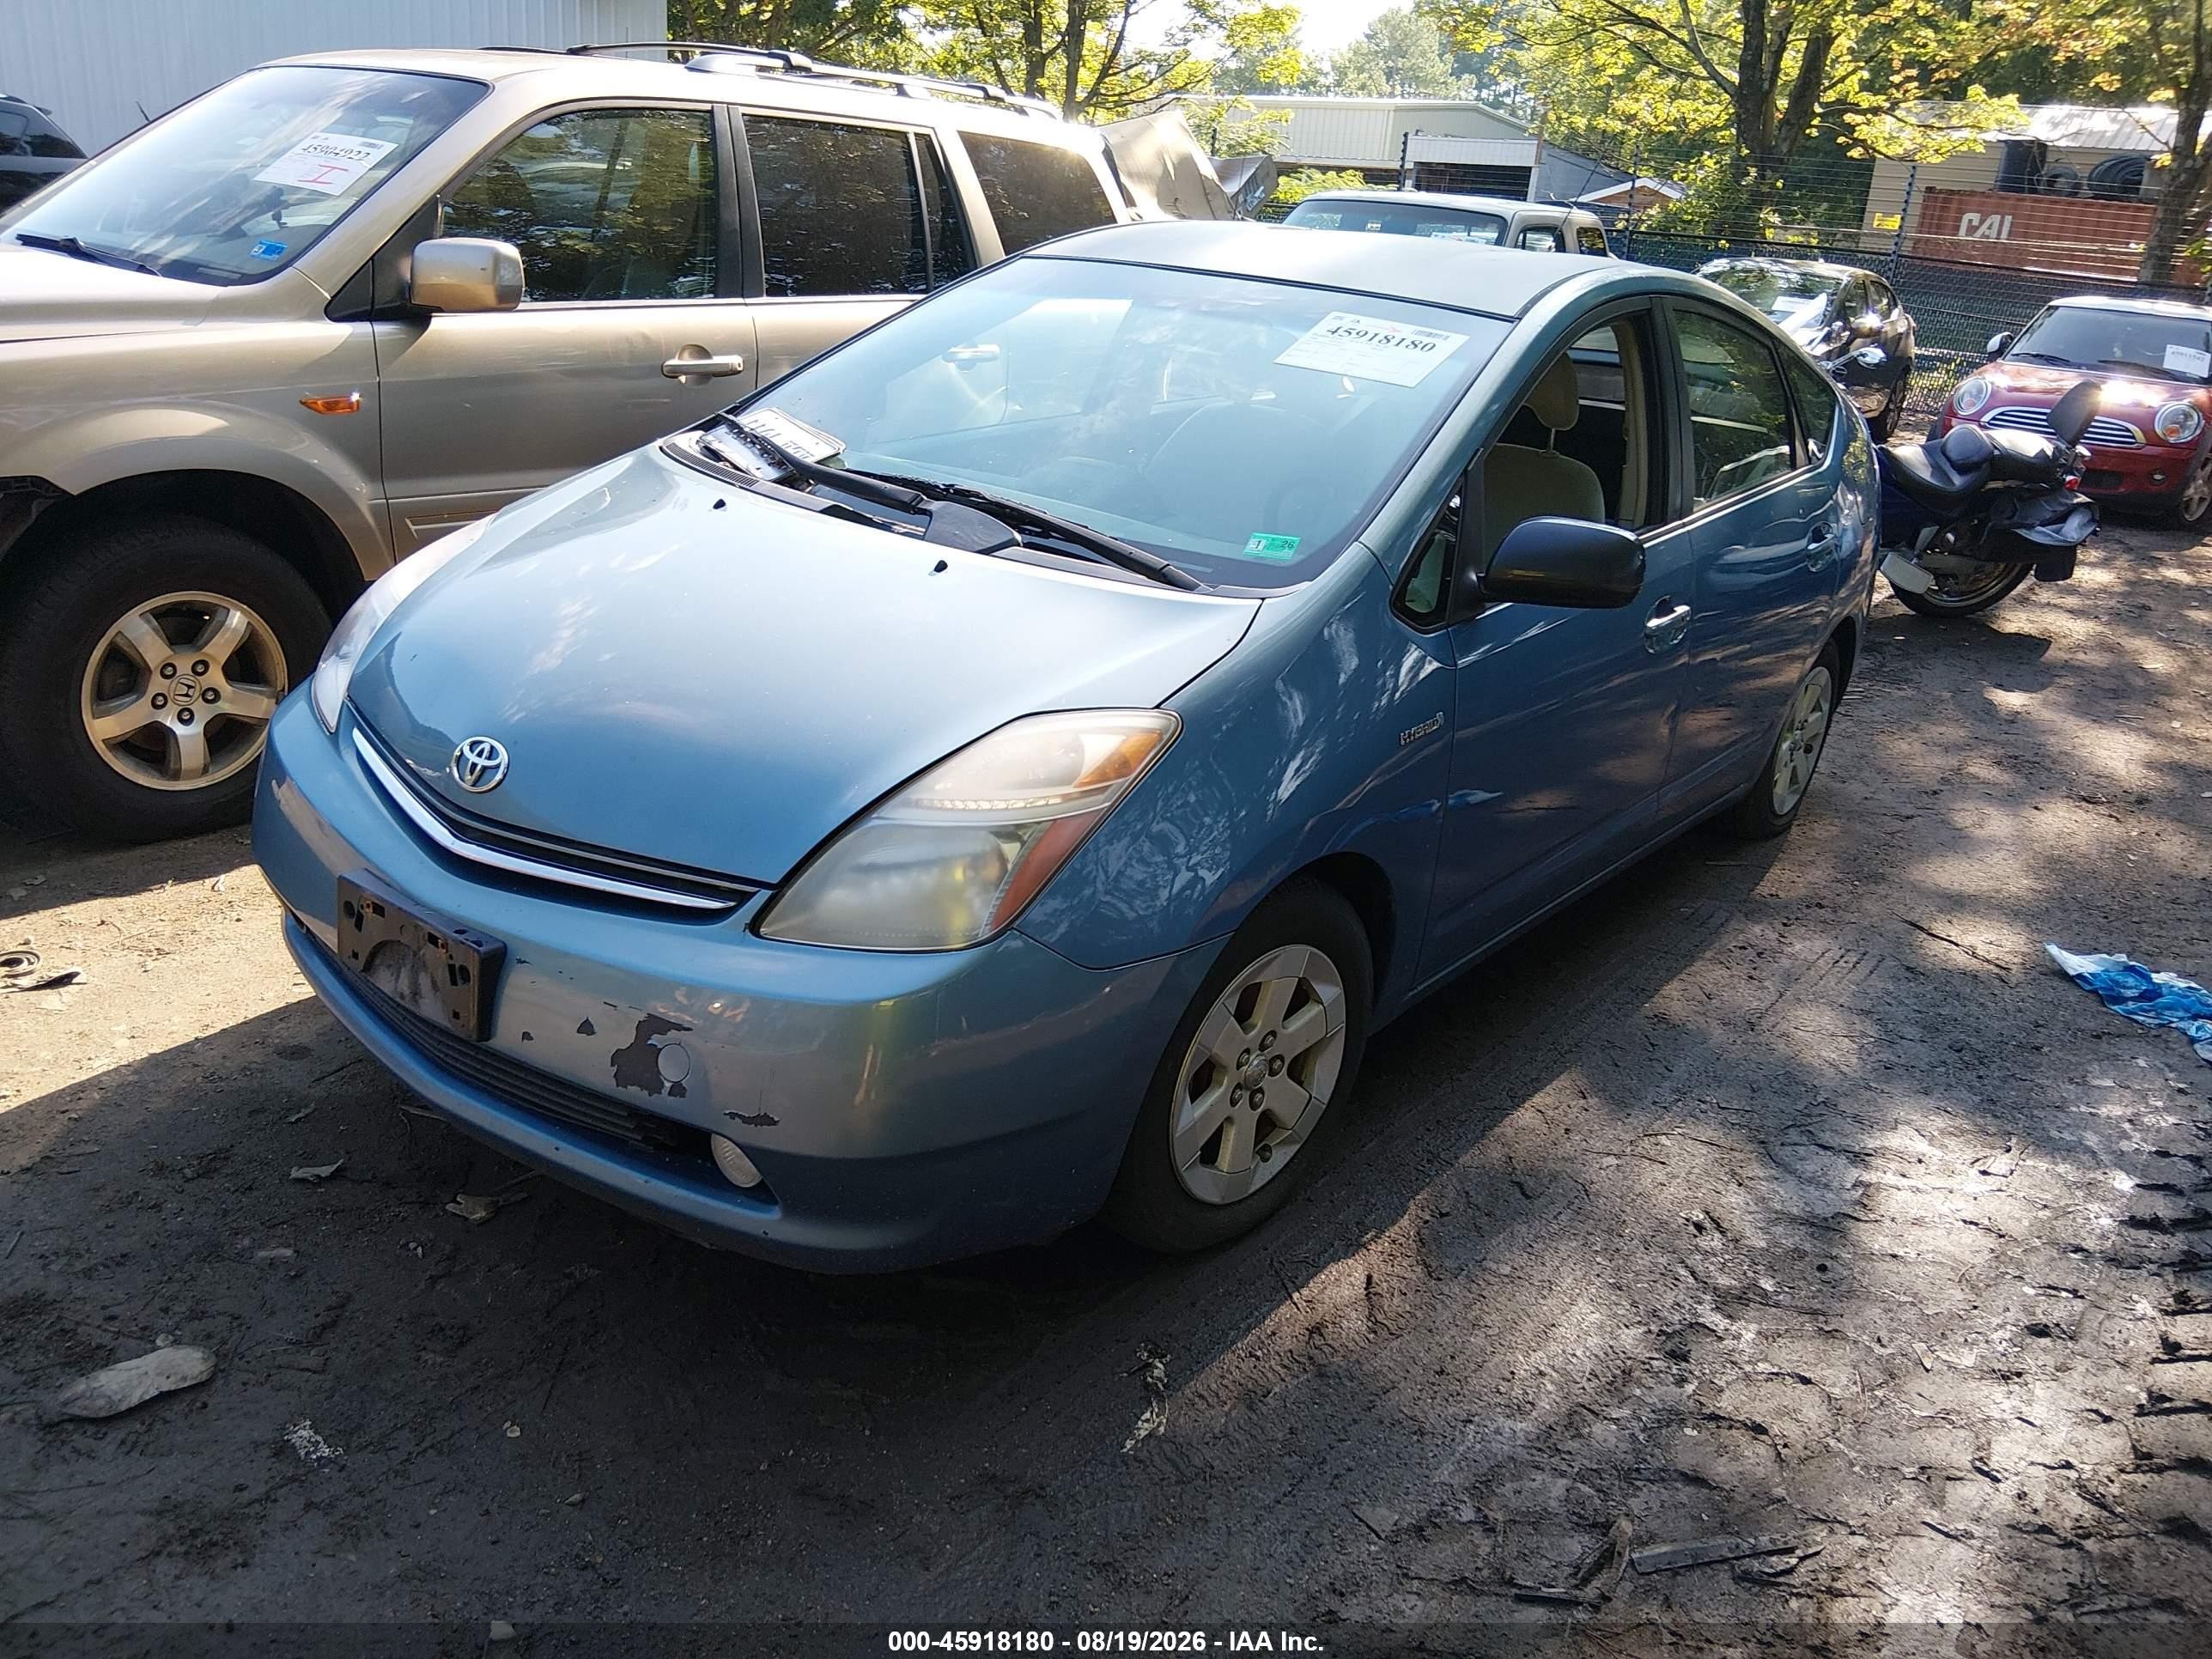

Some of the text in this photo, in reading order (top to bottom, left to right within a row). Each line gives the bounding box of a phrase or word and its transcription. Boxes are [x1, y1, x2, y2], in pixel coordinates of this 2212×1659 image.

[1959, 212, 2013, 239] CAI
[1326, 325, 1437, 353] 45918180
[1255, 539, 1262, 549] 1
